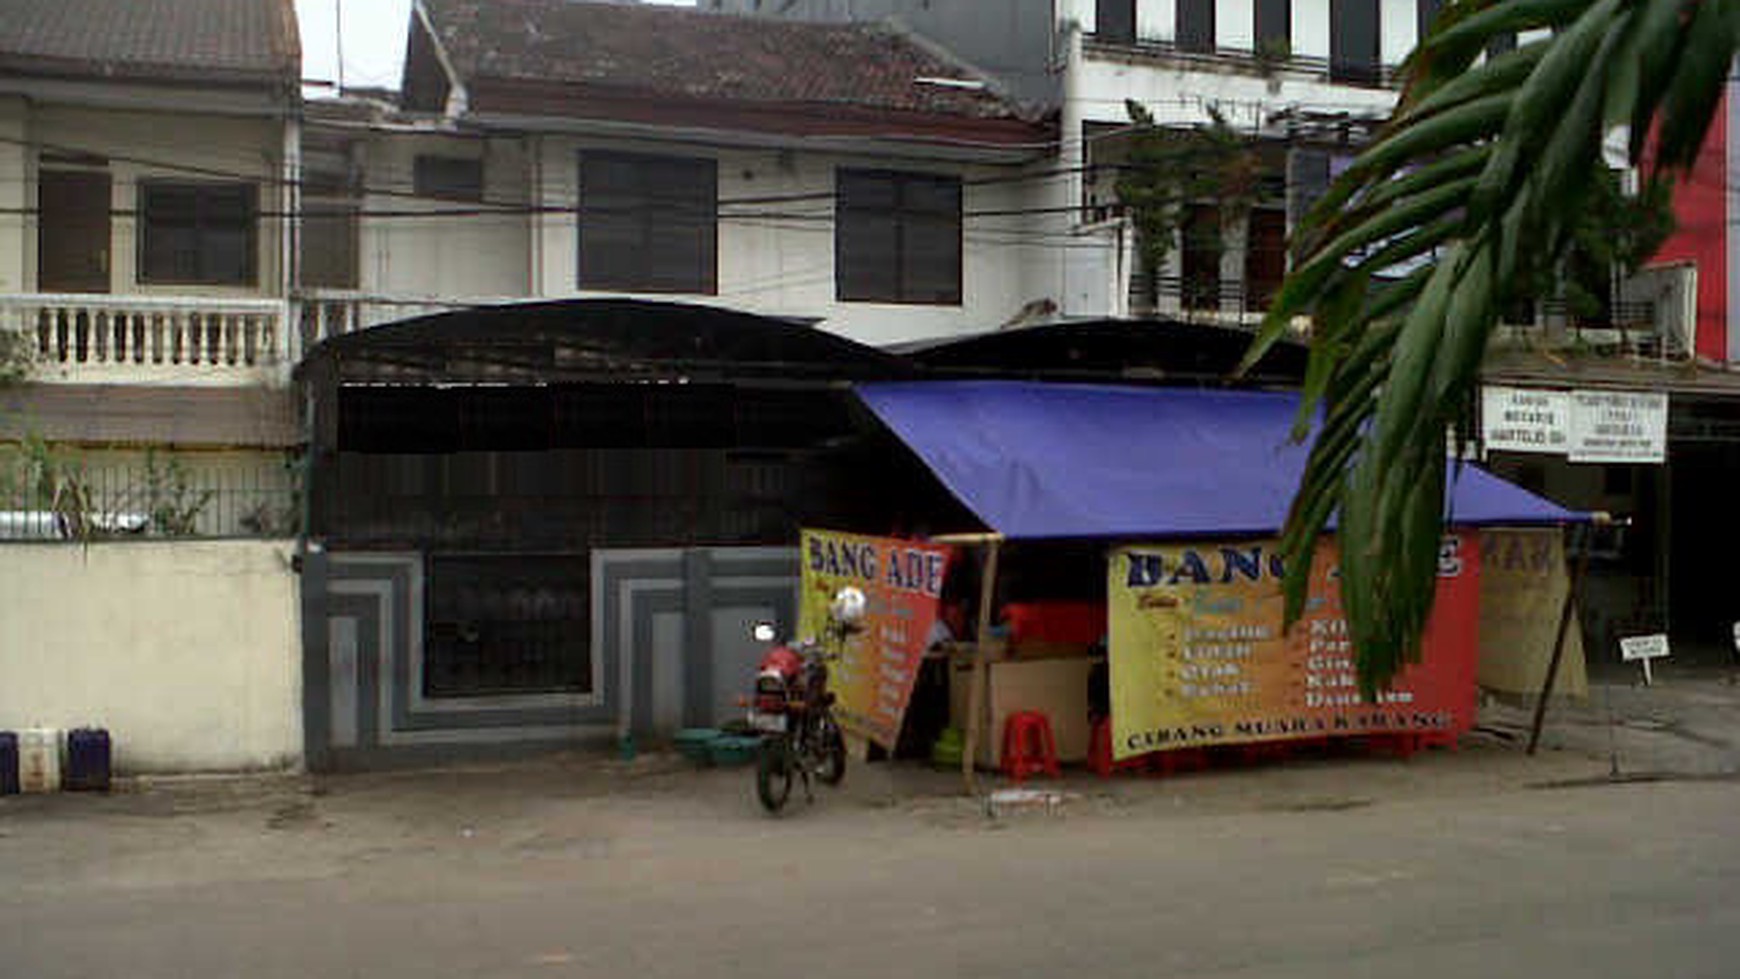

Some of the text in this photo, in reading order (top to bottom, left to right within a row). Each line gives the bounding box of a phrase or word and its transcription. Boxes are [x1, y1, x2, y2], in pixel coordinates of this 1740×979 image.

[809, 536, 943, 596] BANG ADE
[1127, 722, 1223, 751] CABANG
[1234, 716, 1326, 738] MUARA
